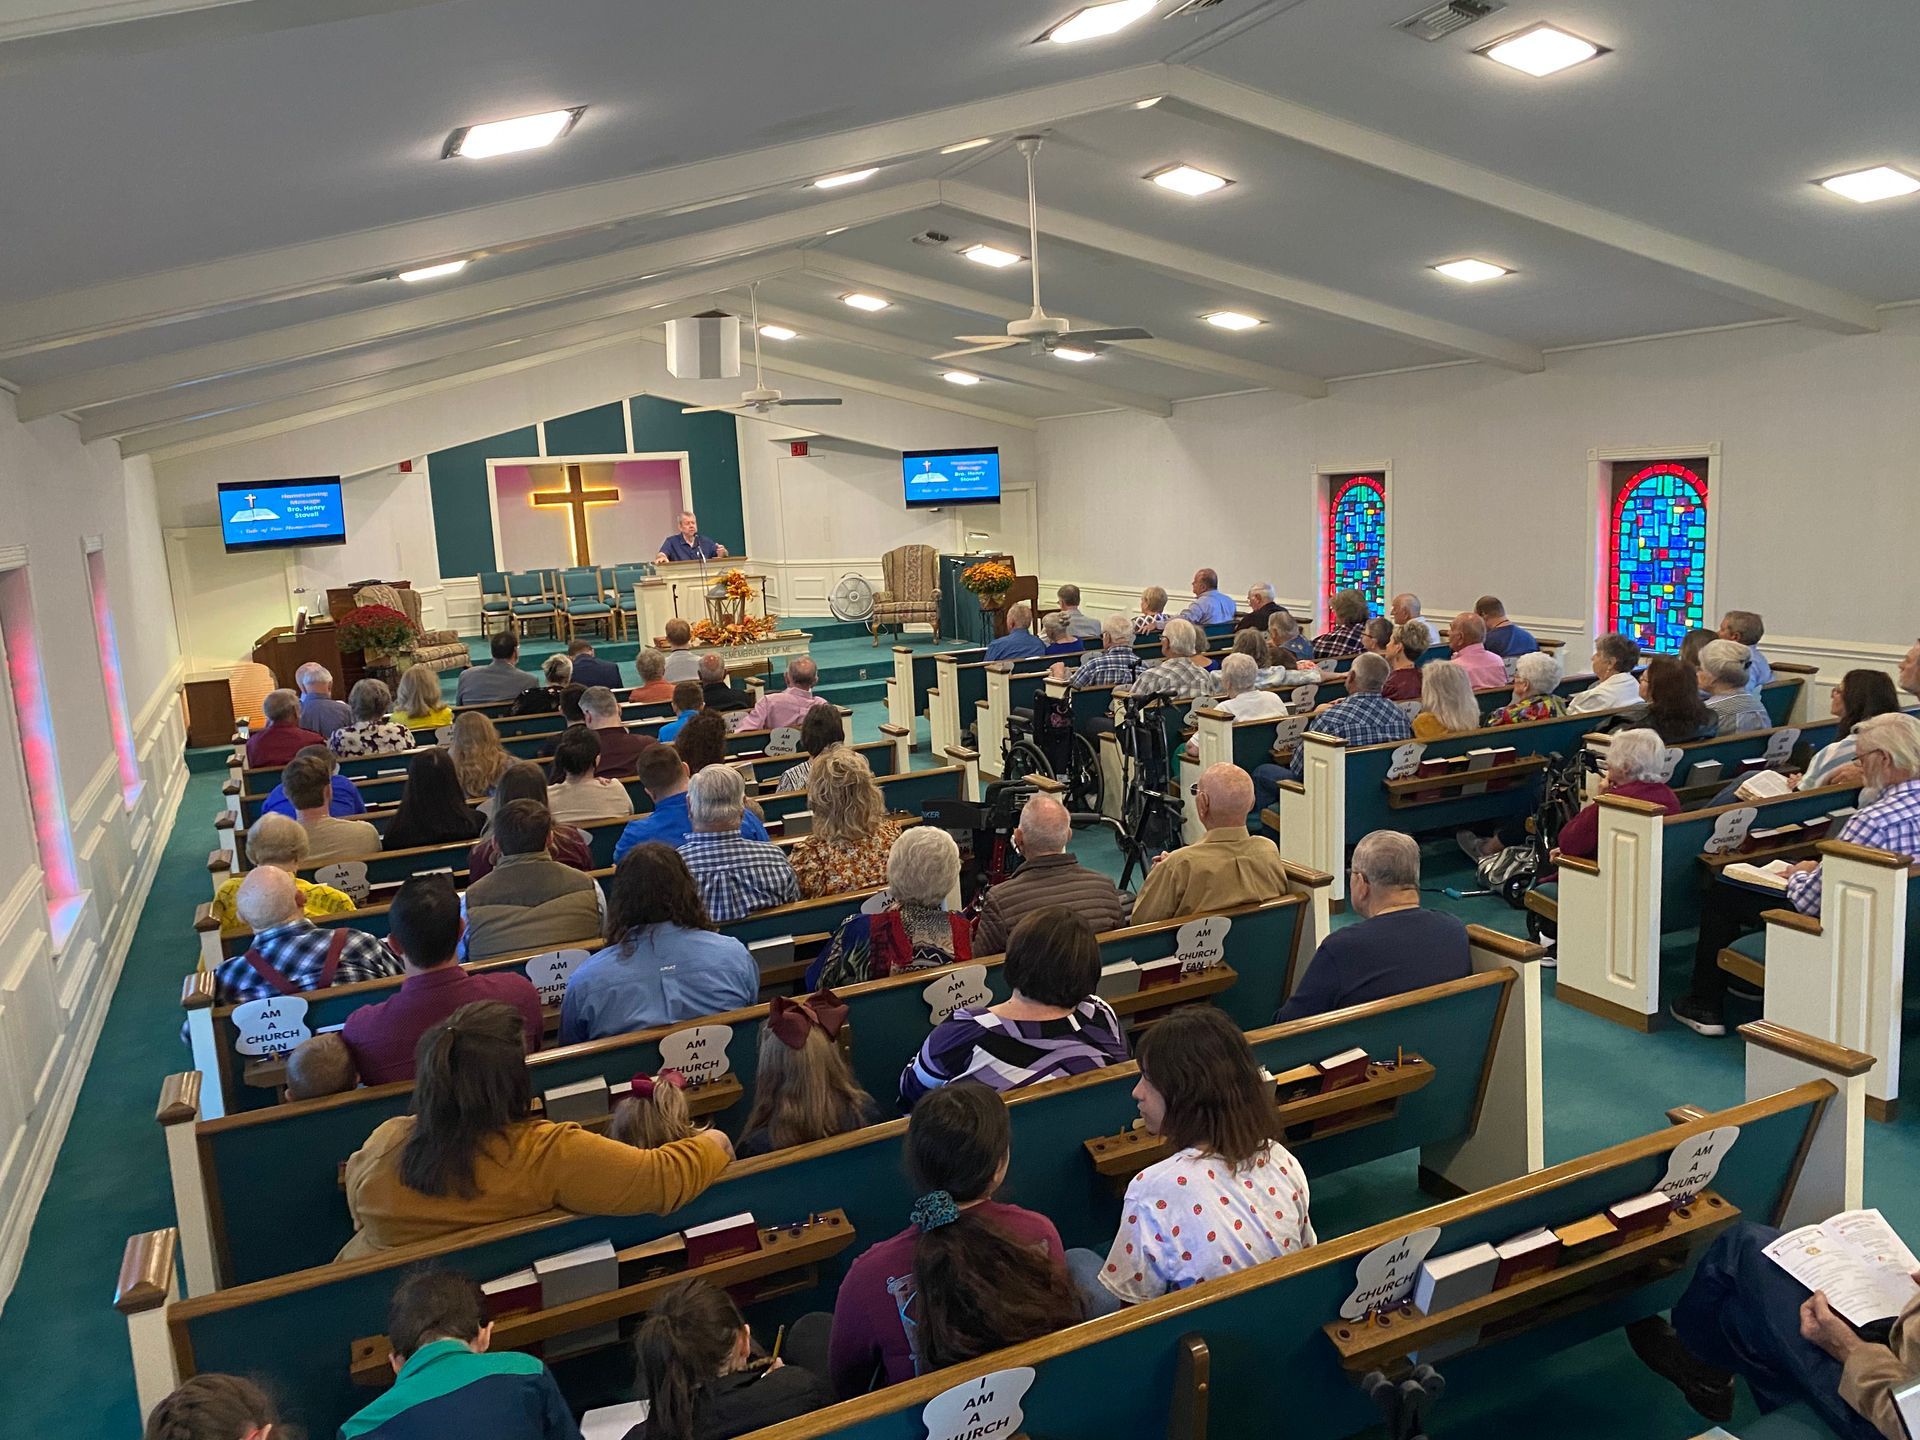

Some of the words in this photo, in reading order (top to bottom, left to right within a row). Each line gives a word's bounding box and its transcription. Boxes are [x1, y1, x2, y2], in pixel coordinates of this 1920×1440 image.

[772, 646, 781, 655] OF
[782, 645, 792, 653] ME
[881, 897, 896, 908] AM
[1195, 929, 1211, 938] AM
[1196, 940, 1203, 948] A
[1178, 948, 1217, 961] CHURCH
[549, 961, 568, 971] AM
[554, 973, 563, 981] A
[951, 973, 955, 981] I
[536, 982, 569, 995] CHUR
[947, 980, 965, 993] AM
[955, 992, 963, 1000] A
[267, 999, 271, 1007] I
[938, 993, 983, 1017] CHURCH
[260, 1009, 281, 1019] AM
[267, 1022, 277, 1030] A
[246, 1029, 300, 1044] CHURCH
[695, 1028, 700, 1036] I
[262, 1043, 287, 1053] FAN
[686, 1039, 706, 1050] AM
[690, 1052, 699, 1061] A
[671, 1060, 720, 1074] HURCH
[685, 1074, 705, 1084] AN
[1709, 1131, 1715, 1140] I
[1692, 1144, 1714, 1158] AM
[1688, 1162, 1698, 1172] A
[1662, 1171, 1712, 1192] CHURCH
[1402, 1236, 1408, 1247] I
[1385, 1249, 1410, 1267] AM
[1385, 1267, 1395, 1280] A
[1355, 1271, 1415, 1303] CHURCH
[980, 1377, 986, 1389] I
[963, 1391, 994, 1412] AM
[967, 1412, 981, 1426] A
[947, 1416, 1010, 1440] URCH
